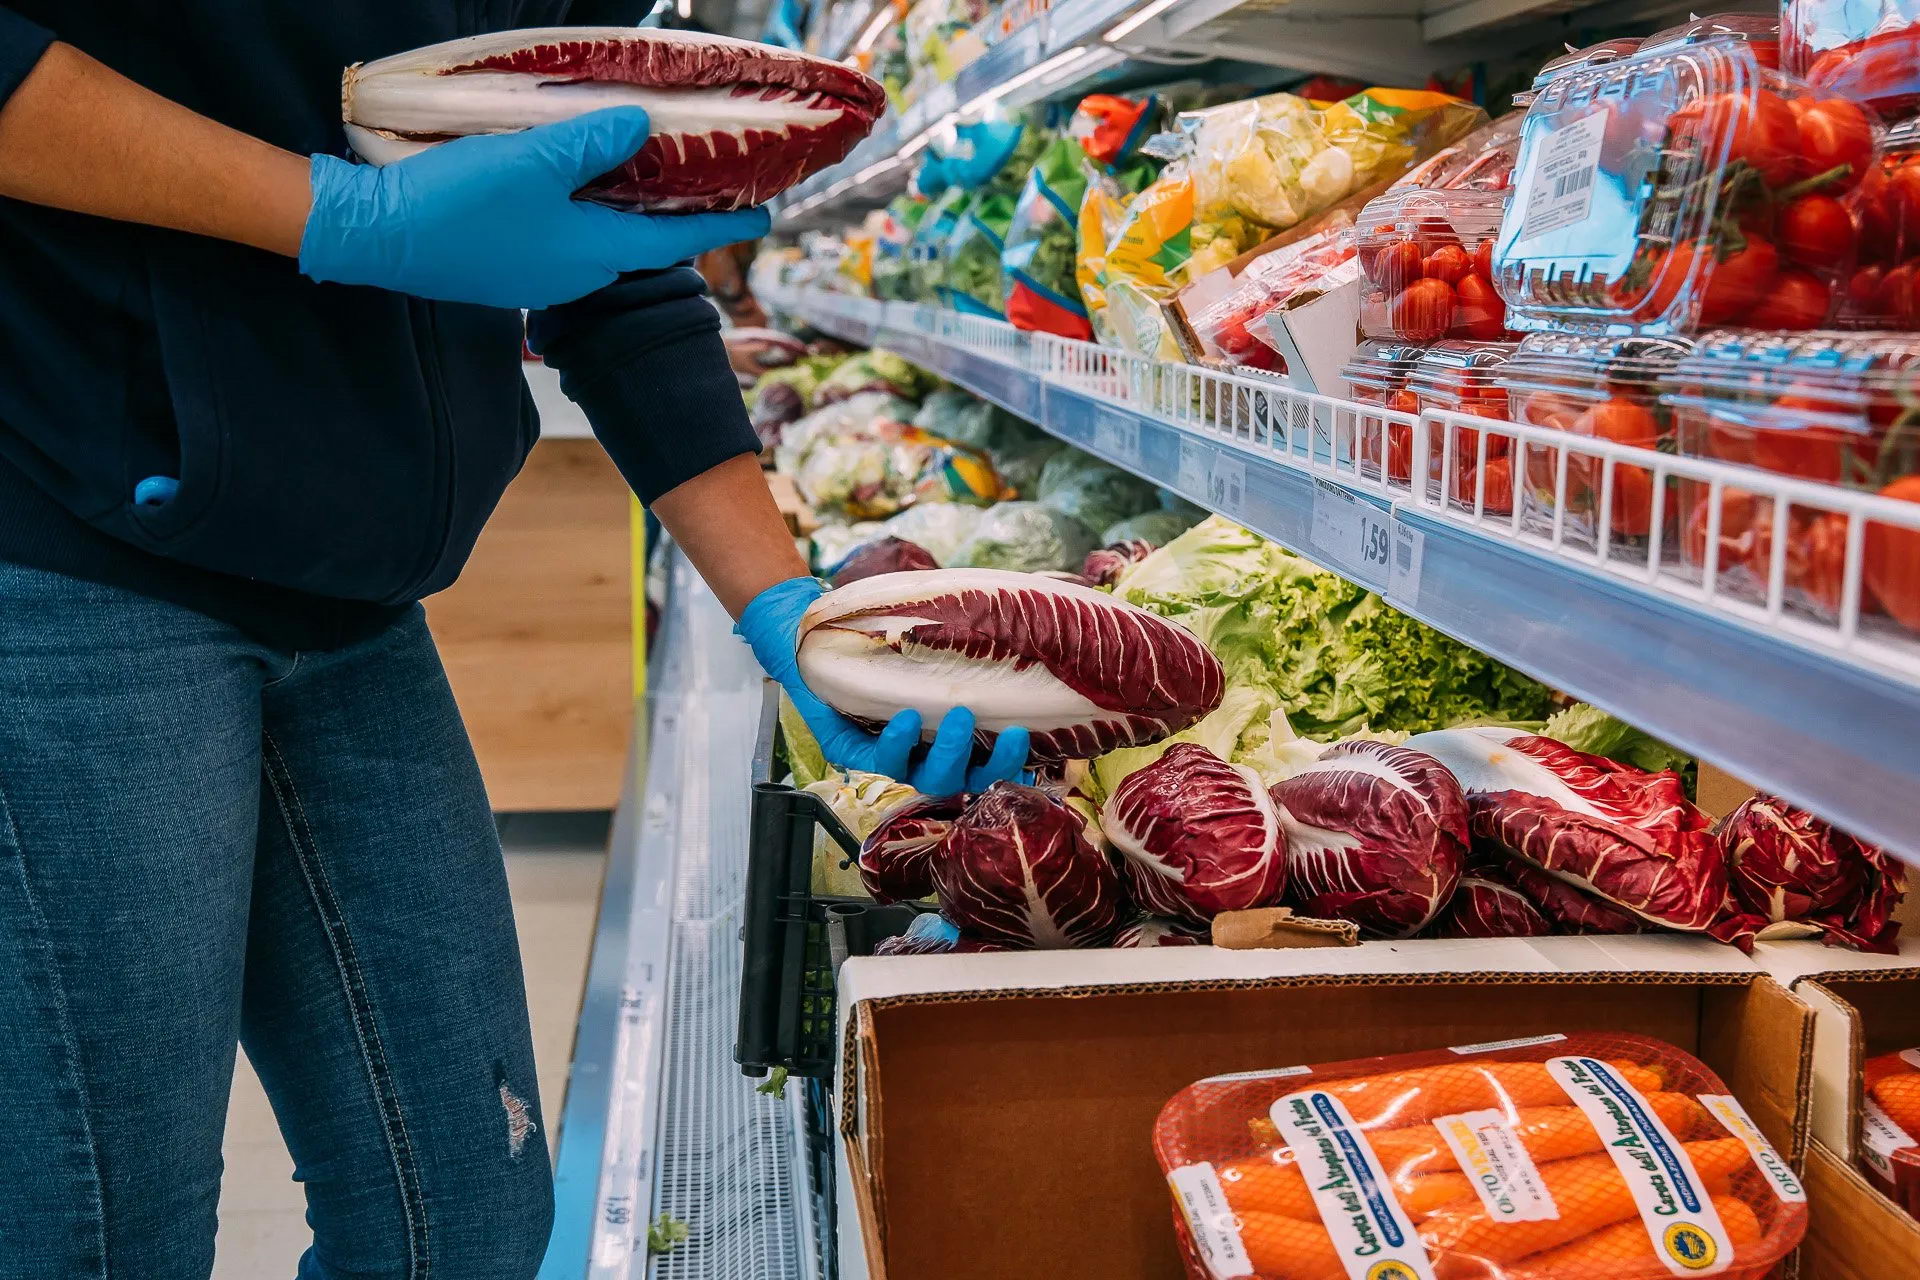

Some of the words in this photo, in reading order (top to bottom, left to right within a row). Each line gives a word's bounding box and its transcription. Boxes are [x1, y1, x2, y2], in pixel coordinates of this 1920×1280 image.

[1361, 517, 1389, 565] 1,59
[1560, 1060, 1594, 1084] Fucino
[1582, 1084, 1606, 1096] del
[1618, 1092, 1661, 1144] GEOGRAFICA
[1650, 1174, 1679, 1215] Carota
[1656, 1145, 1696, 1207] INDICAZIONE
[1352, 1213, 1381, 1256] Carota
